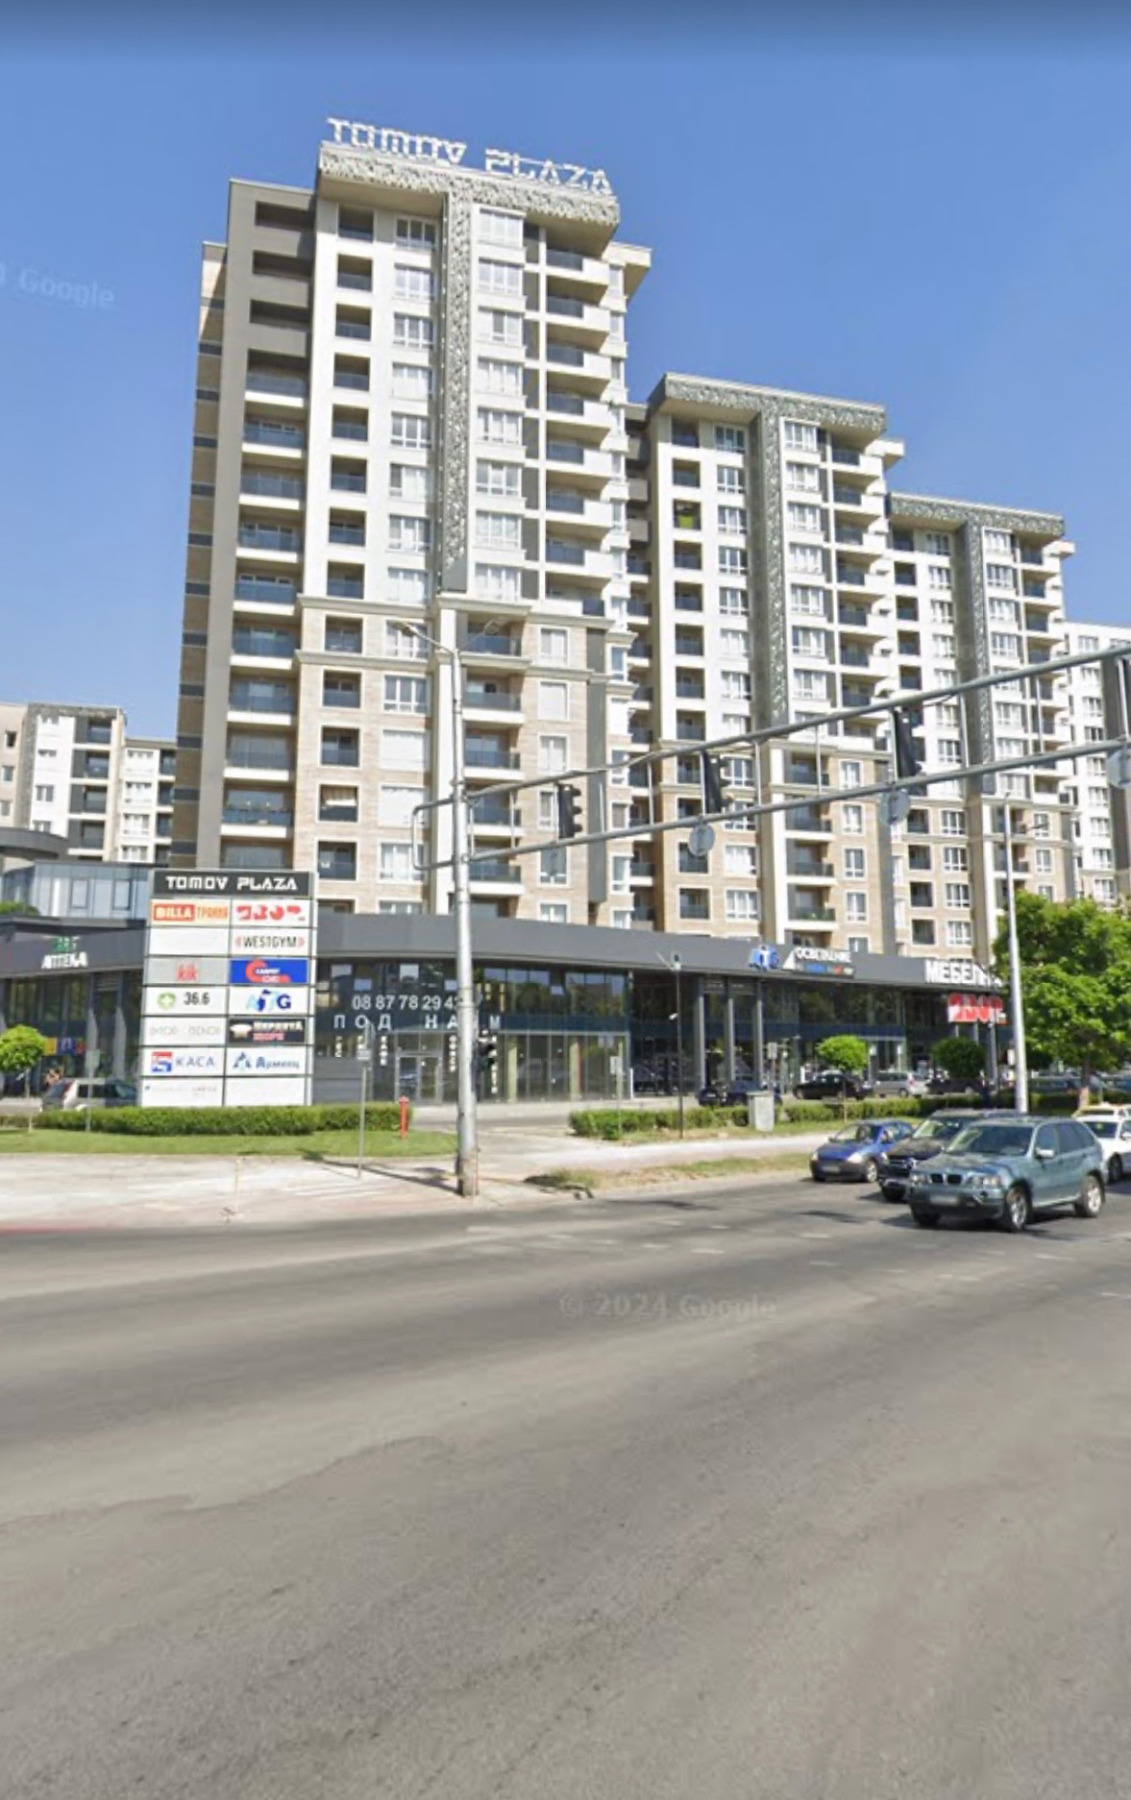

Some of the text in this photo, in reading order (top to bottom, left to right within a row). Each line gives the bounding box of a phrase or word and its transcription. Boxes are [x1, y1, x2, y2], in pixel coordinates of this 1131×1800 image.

[326, 117, 614, 196] TOMOV PLAZA
[165, 876, 298, 890] TOMOV PLAZA
[155, 907, 193, 919] BILLA
[243, 935, 297, 948] WESTGYM
[183, 992, 211, 1006] 36.6
[353, 995, 371, 1010] 08
[375, 995, 394, 1010] 87
[399, 995, 418, 1010] 78
[421, 994, 441, 1010] 29
[333, 1014, 392, 1031] ПОД
[175, 1056, 215, 1068] КАСА
